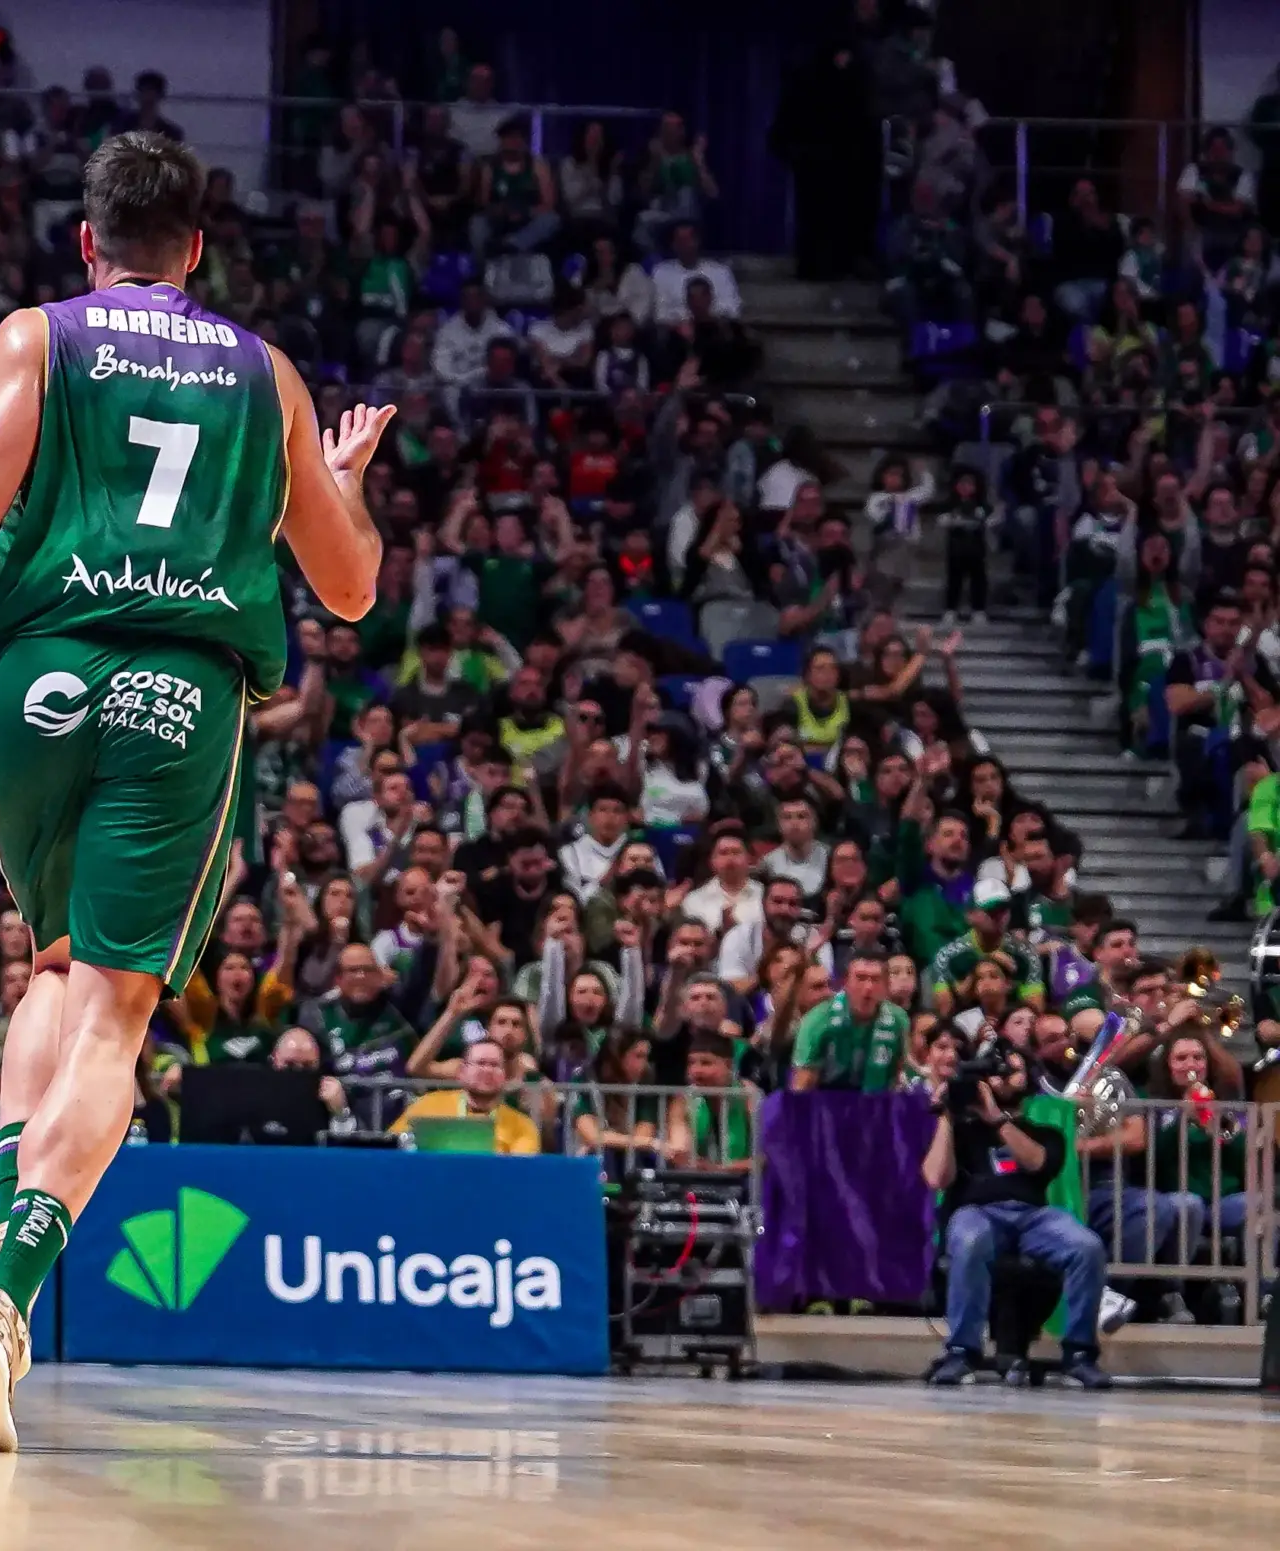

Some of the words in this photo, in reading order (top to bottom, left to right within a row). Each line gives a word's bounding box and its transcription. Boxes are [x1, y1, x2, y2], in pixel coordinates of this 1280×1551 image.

[86, 306, 238, 347] BARREIRO
[128, 415, 200, 529] 7
[62, 553, 239, 612] Andalucía
[103, 691, 148, 711] DEL
[152, 697, 195, 731] SOL
[110, 671, 202, 712] COSTA
[264, 1234, 562, 1328] Unicaja
